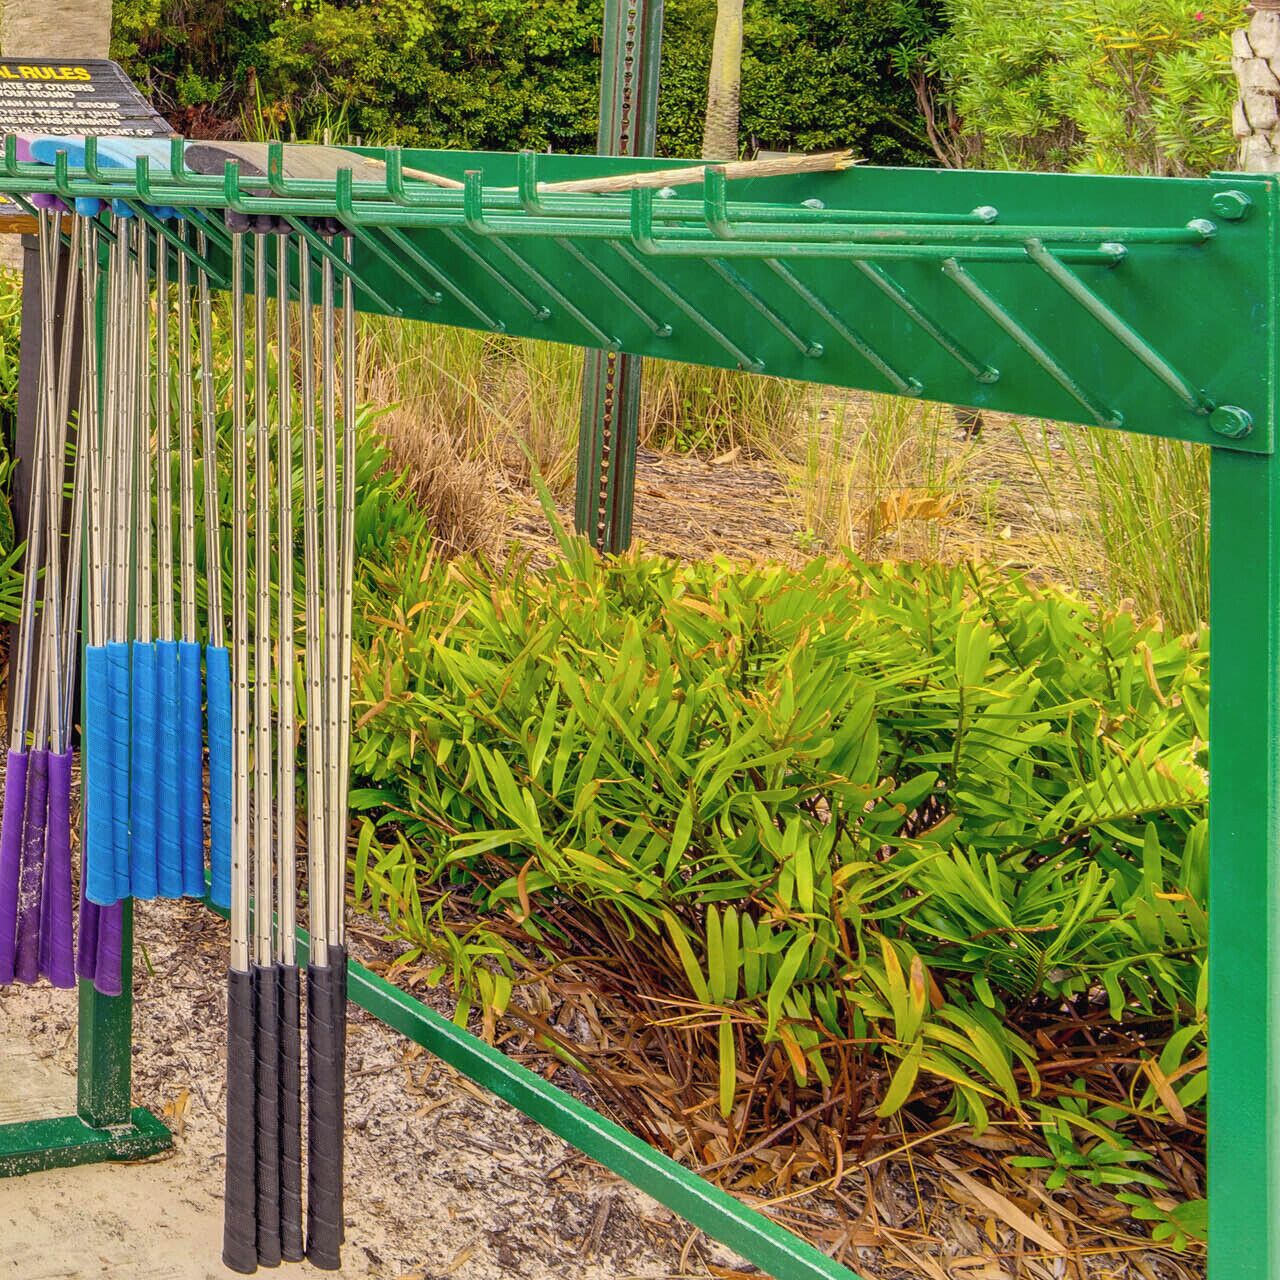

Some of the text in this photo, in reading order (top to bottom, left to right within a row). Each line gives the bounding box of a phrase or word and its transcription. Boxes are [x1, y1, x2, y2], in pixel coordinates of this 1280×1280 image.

[17, 66, 92, 81] RULES
[26, 83, 43, 91] OF
[45, 84, 96, 92] OTHERS
[30, 90, 76, 99] ROUND
[48, 101, 75, 109] ANY
[76, 101, 121, 109] GROUP
[35, 117, 63, 125] HAS
[62, 117, 121, 126] FINISHED
[50, 127, 78, 136] CUT
[91, 128, 134, 136] FRONT
